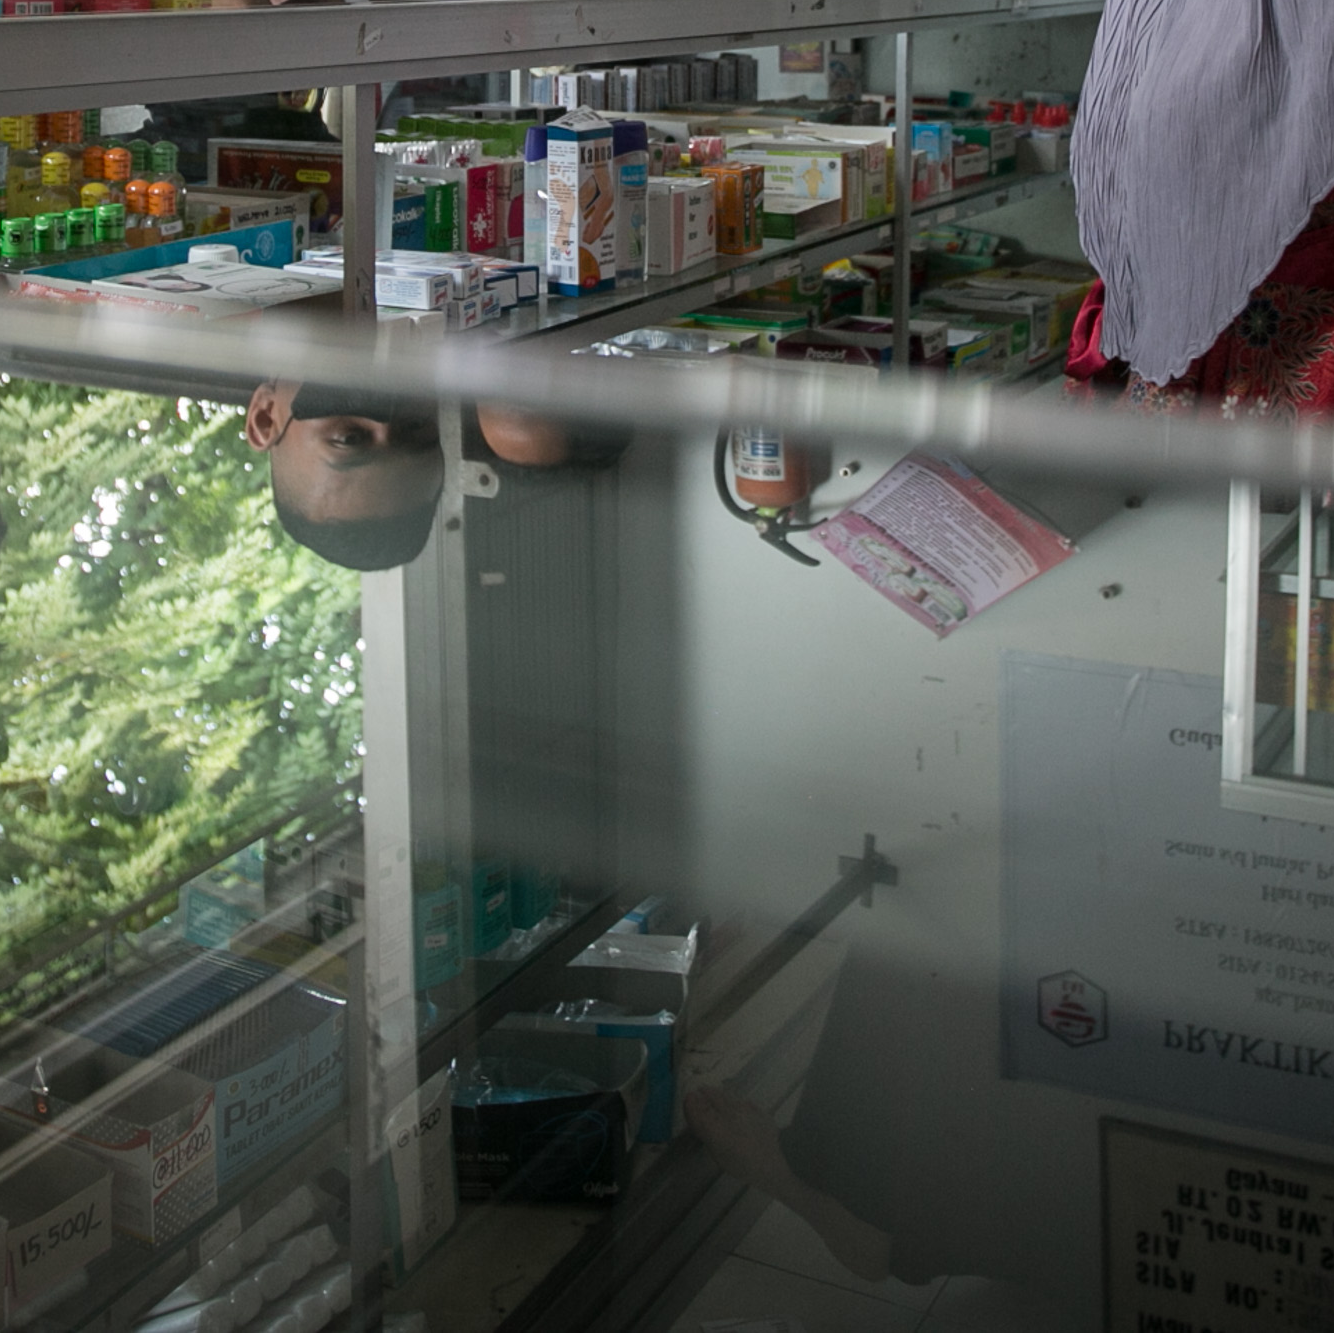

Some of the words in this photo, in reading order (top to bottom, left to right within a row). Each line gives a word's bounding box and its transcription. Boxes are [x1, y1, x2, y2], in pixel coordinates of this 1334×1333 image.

[578, 146, 614, 166] Kanna
[223, 1047, 347, 1139] Paramex
[223, 1130, 261, 1162] TABLET
[261, 1117, 288, 1144] OBAT
[288, 1099, 317, 1130] SAKIT
[477, 1150, 510, 1164] Mask
[19, 1202, 102, 1268] 15.500/-
